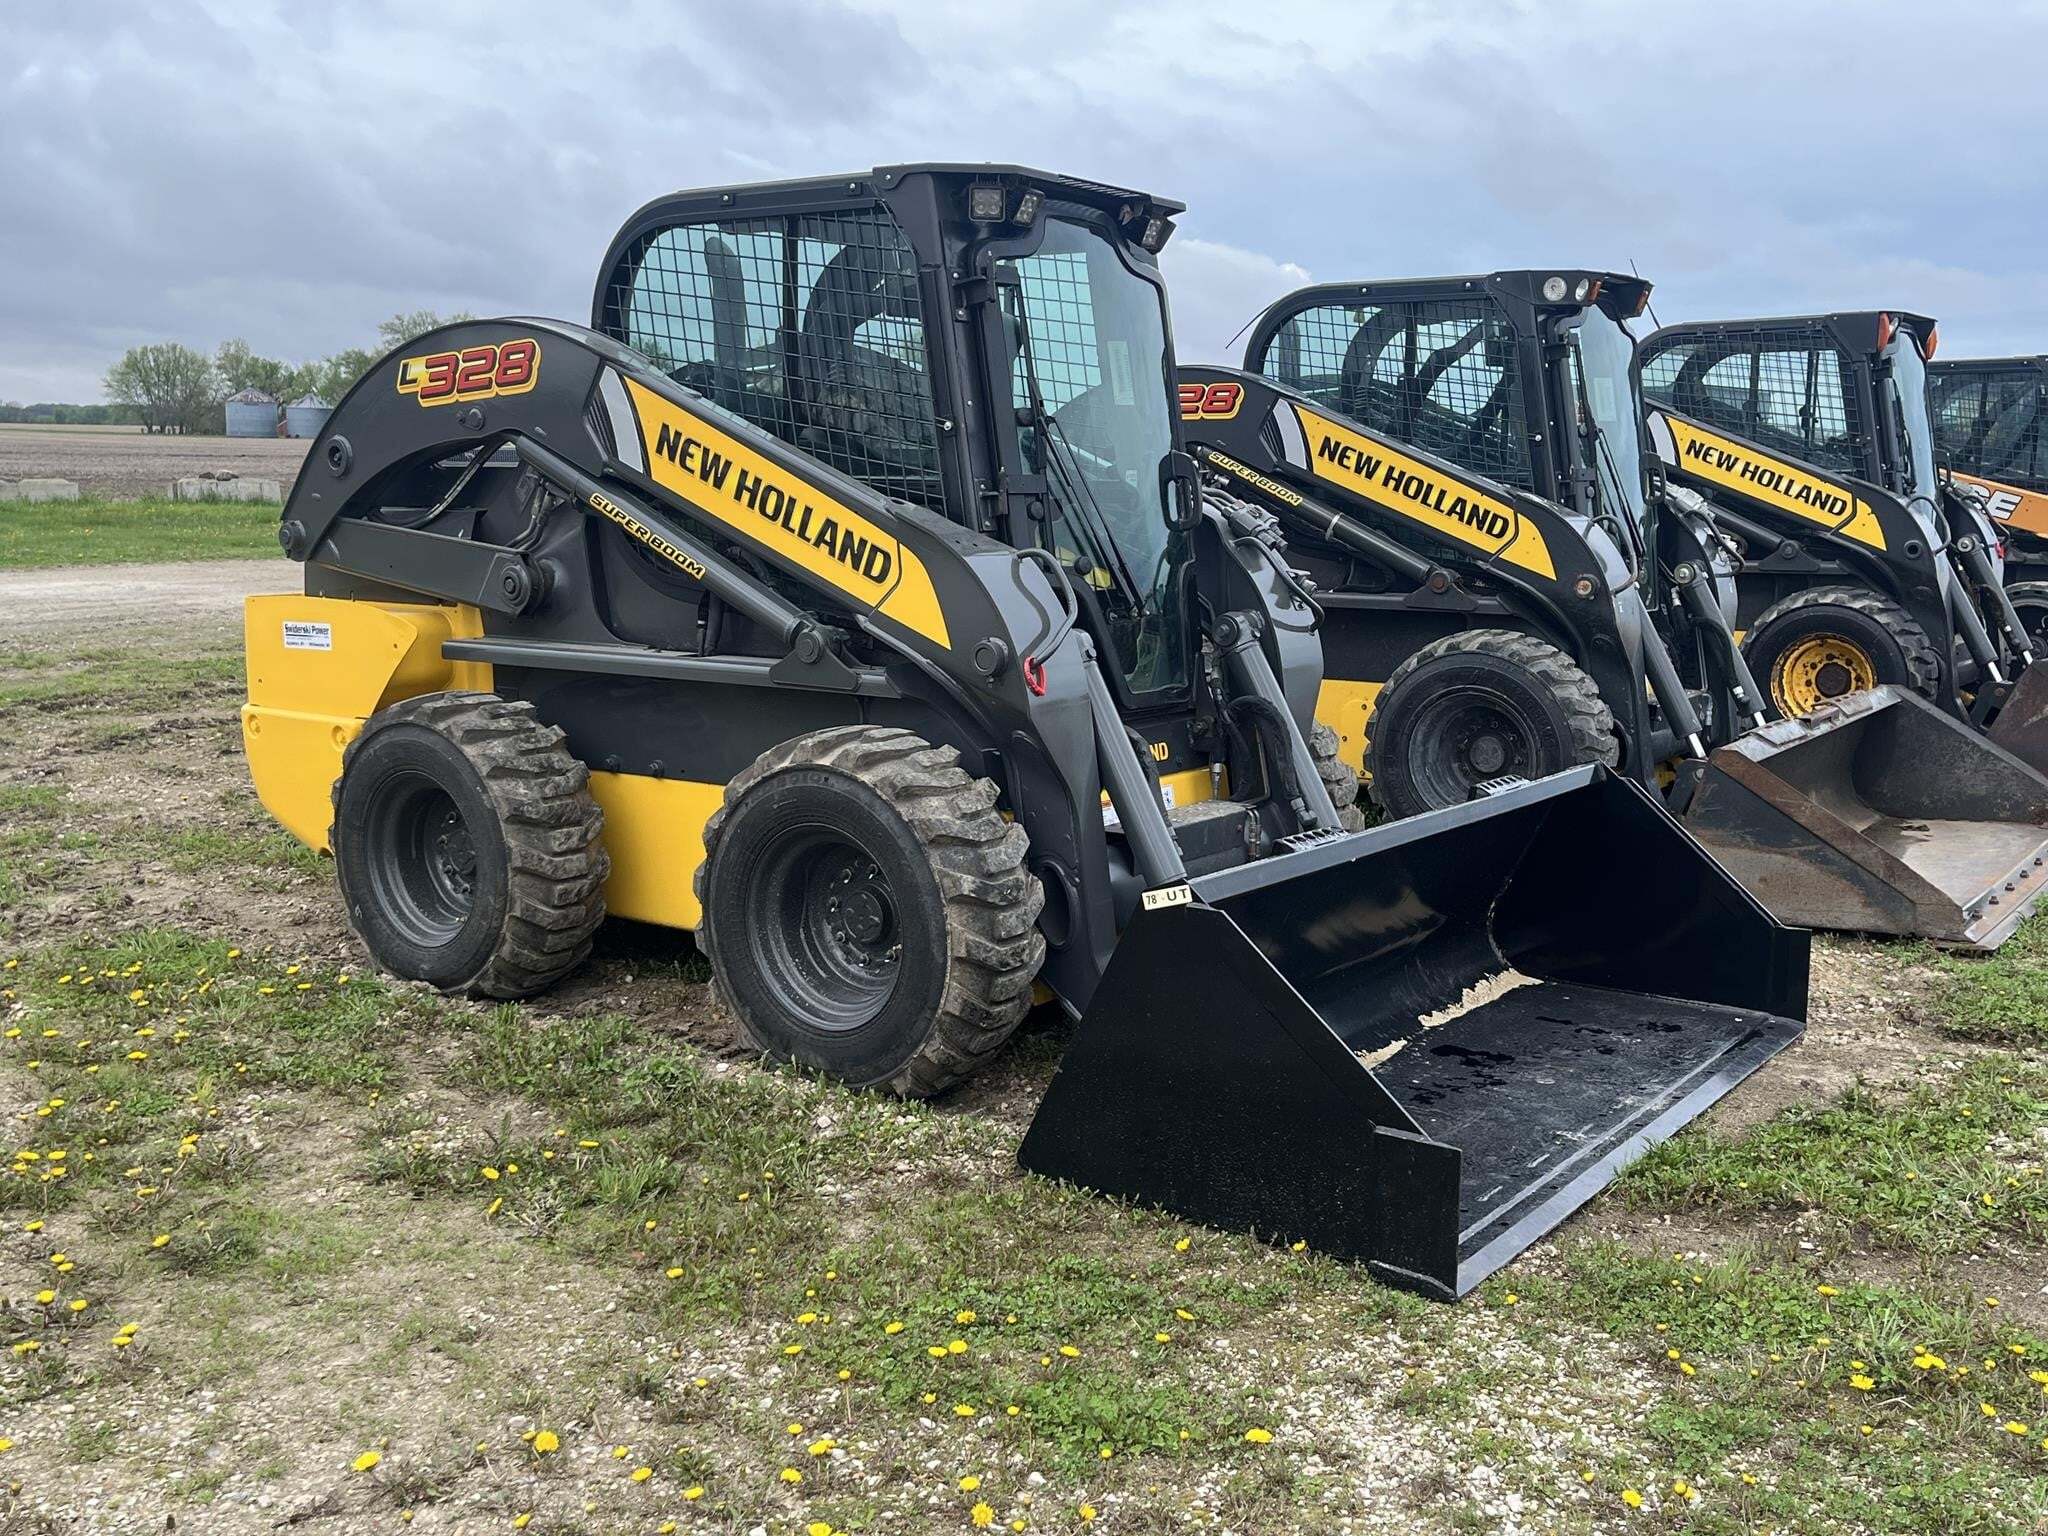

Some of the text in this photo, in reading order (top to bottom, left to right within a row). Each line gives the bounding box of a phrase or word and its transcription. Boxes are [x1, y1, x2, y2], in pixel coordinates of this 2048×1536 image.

[397, 338, 541, 407] L328
[655, 422, 893, 585] NEW HOLLAND
[1209, 451, 1302, 506] SUPER BOOM
[1318, 435, 1510, 539] NEW HOLLAND
[1685, 438, 1848, 516] NEW HOLLAND
[590, 493, 705, 579] SUPER BOOM
